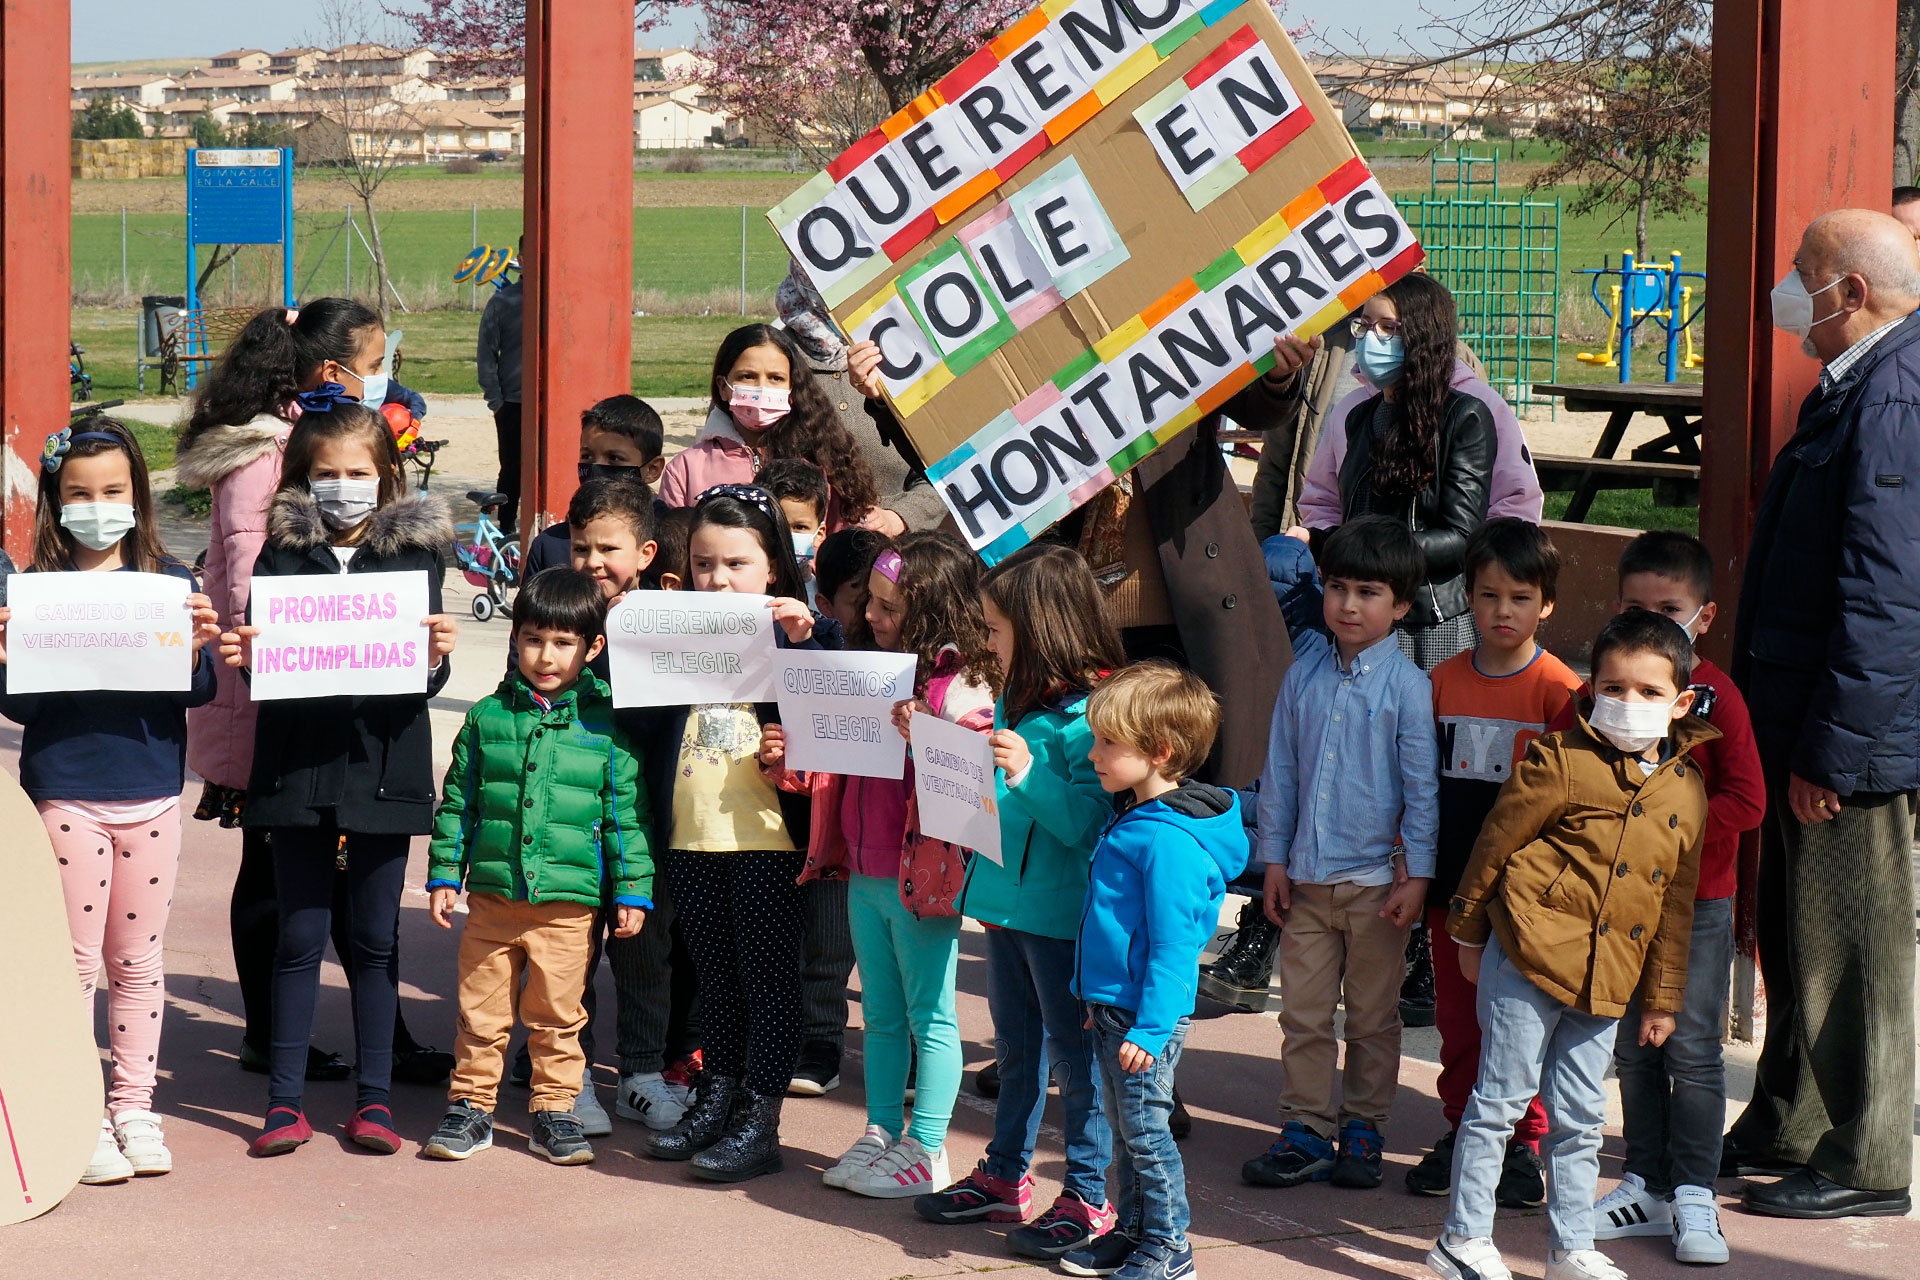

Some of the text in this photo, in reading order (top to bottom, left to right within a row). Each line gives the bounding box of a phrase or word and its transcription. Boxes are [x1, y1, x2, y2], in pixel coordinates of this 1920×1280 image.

[197, 178, 277, 186] EN LA CALLE
[203, 169, 272, 177] GIMNASIO
[875, 56, 1290, 381] COLE EN
[945, 189, 1401, 539] HONTANARES
[35, 602, 165, 621] CAMBIO DE
[269, 592, 398, 624] PROMESAS
[619, 608, 758, 635] QUEREMOS
[23, 631, 185, 649] VENTANAS YA
[257, 641, 416, 674] INCUMPLIDAS
[651, 651, 743, 674] ELEGIR
[783, 667, 897, 698] QUEREMOS
[812, 713, 882, 743] ELEGIR
[925, 746, 985, 783] CAMBIO DE
[922, 773, 997, 817] VENTANAS YA
